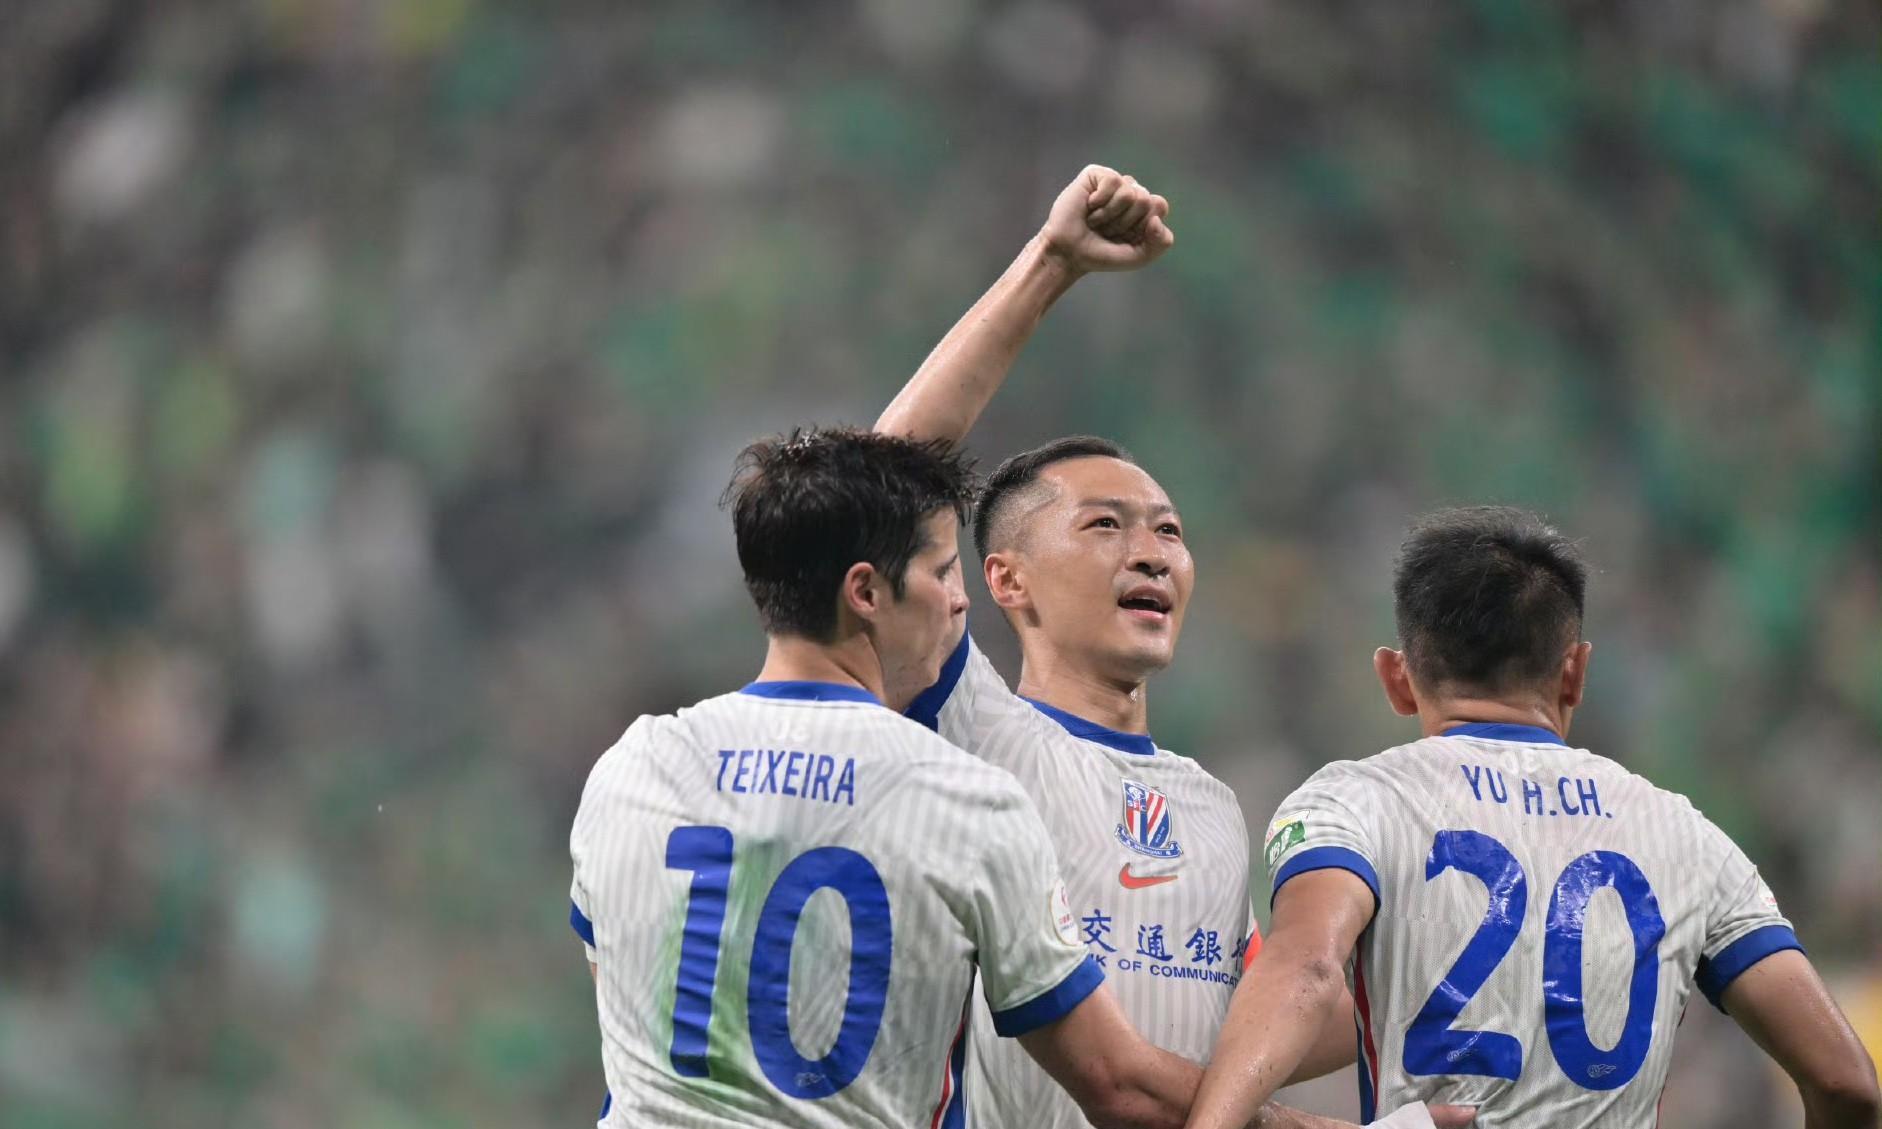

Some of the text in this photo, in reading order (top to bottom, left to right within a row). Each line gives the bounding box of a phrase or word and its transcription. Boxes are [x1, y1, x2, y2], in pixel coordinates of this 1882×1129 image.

[716, 749, 855, 806] TEIXEIRA
[1461, 764, 1614, 819] YU H.CH.
[665, 825, 892, 1100] 10
[1118, 958, 1142, 972] OF
[1402, 829, 1666, 1090] 20
